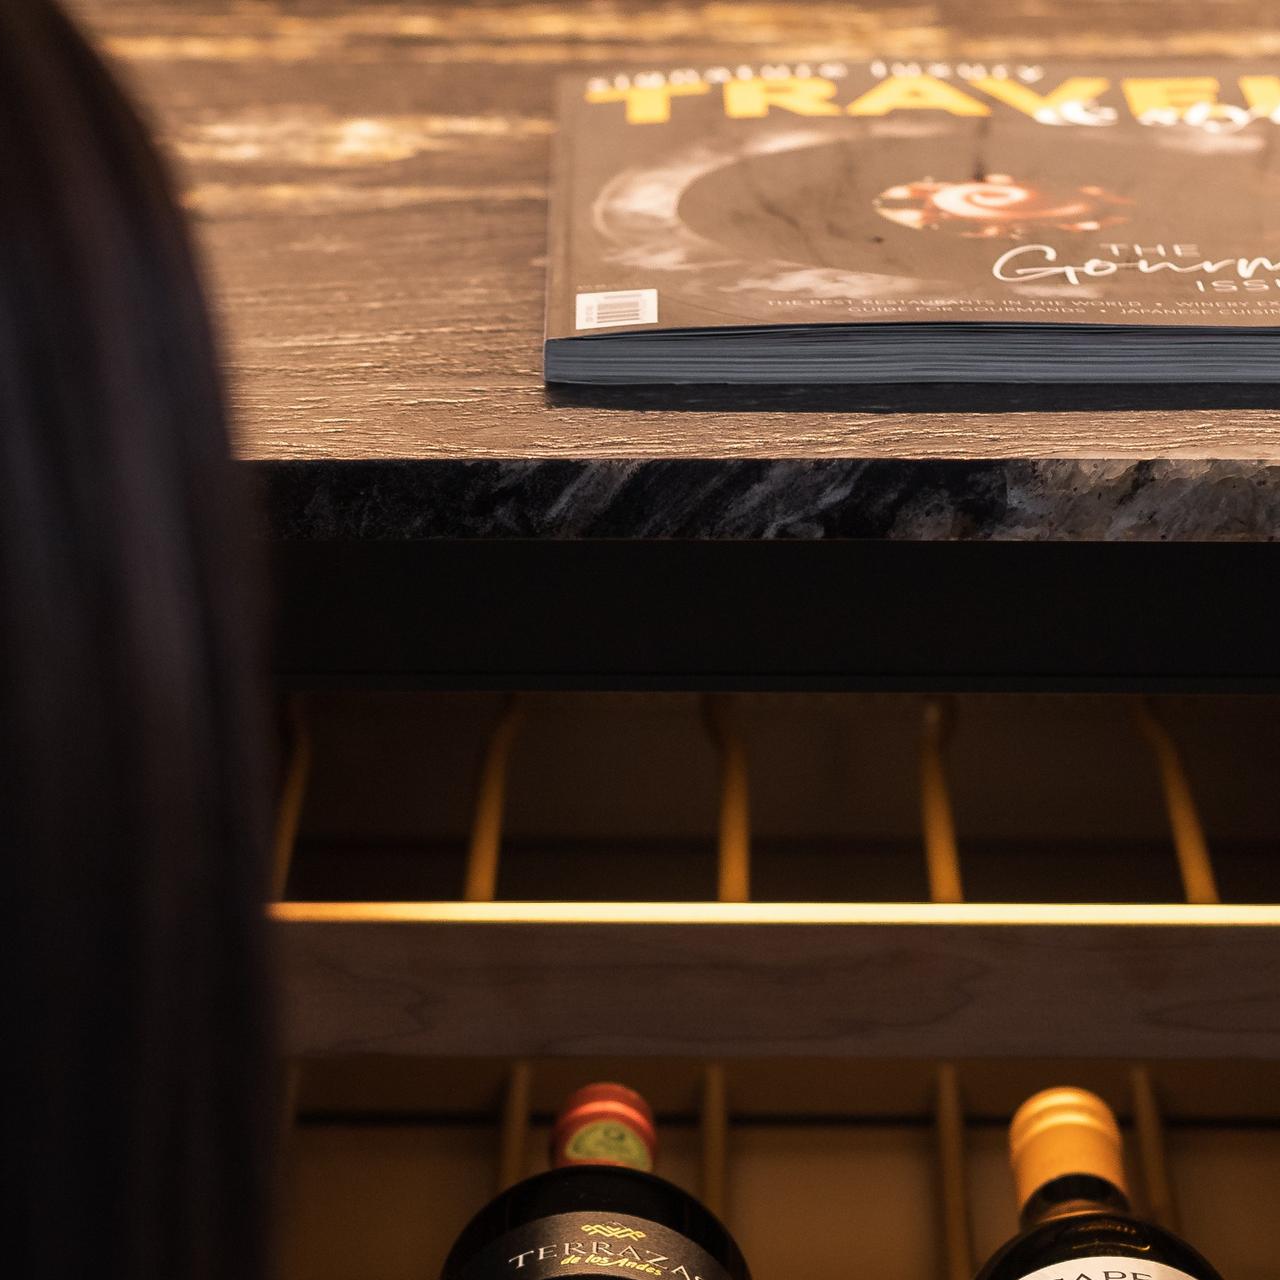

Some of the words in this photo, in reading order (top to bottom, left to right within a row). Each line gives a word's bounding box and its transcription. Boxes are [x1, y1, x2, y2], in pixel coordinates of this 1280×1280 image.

[1099, 243, 1201, 258] THE
[768, 299, 800, 308] THE
[1030, 300, 1067, 308] THE
[1072, 300, 1142, 308] WORLD
[560, 1254, 581, 1266] de
[584, 1253, 610, 1266] los
[601, 1256, 662, 1277] Andes
